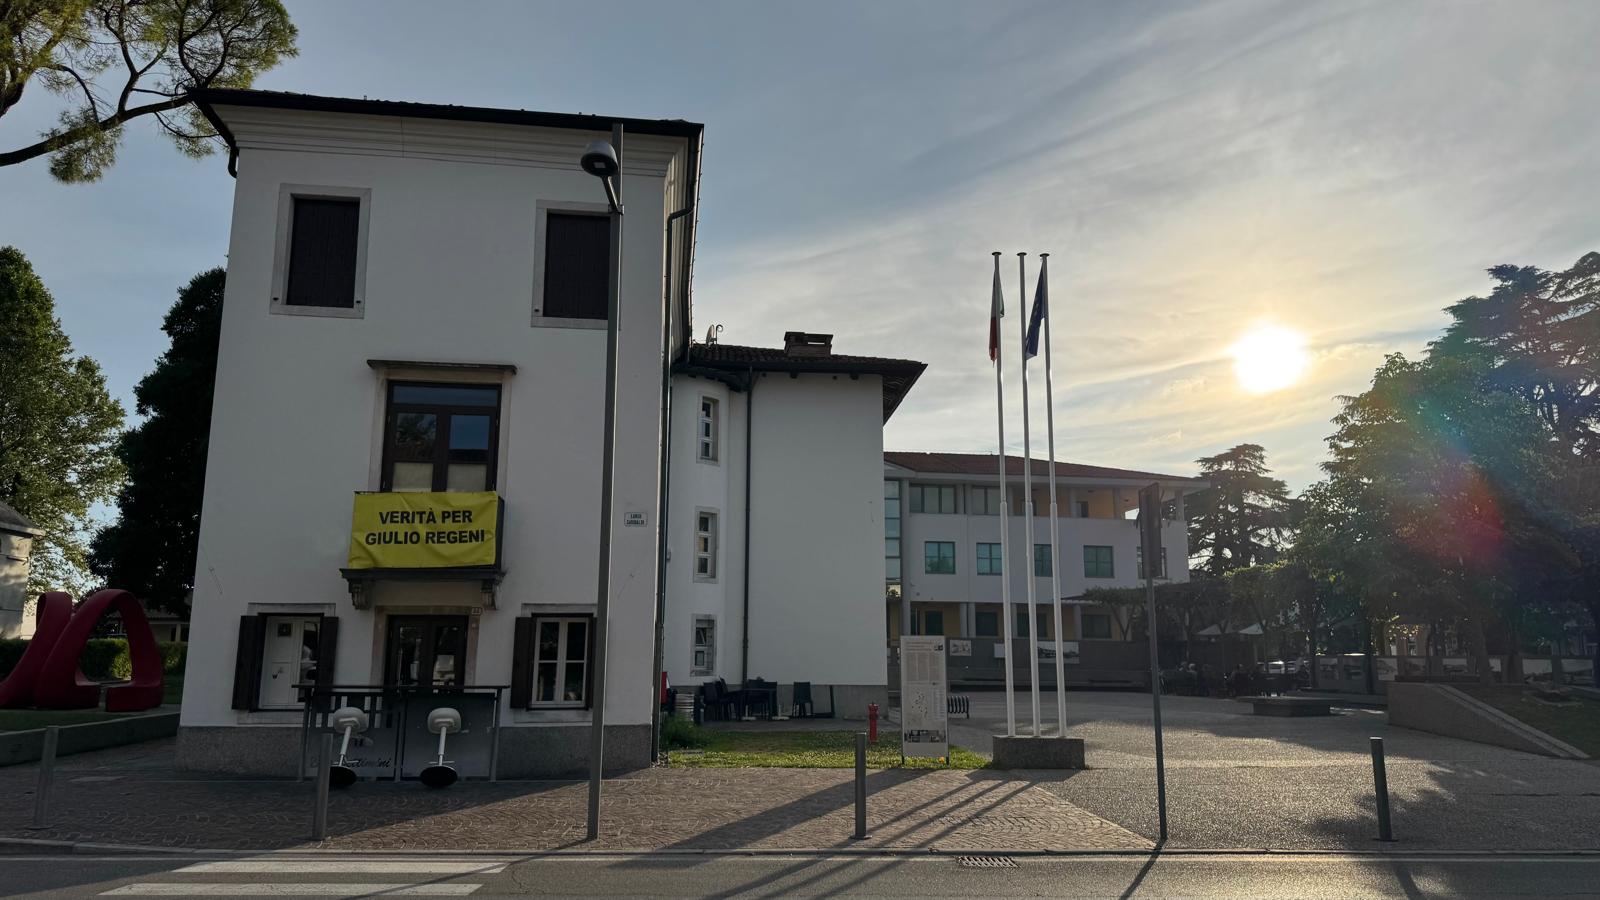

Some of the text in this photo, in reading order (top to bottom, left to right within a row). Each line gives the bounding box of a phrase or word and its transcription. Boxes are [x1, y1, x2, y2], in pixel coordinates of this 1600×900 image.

[379, 508, 473, 524] VERITÀ PER
[365, 529, 485, 545] GIULIO REGENI
